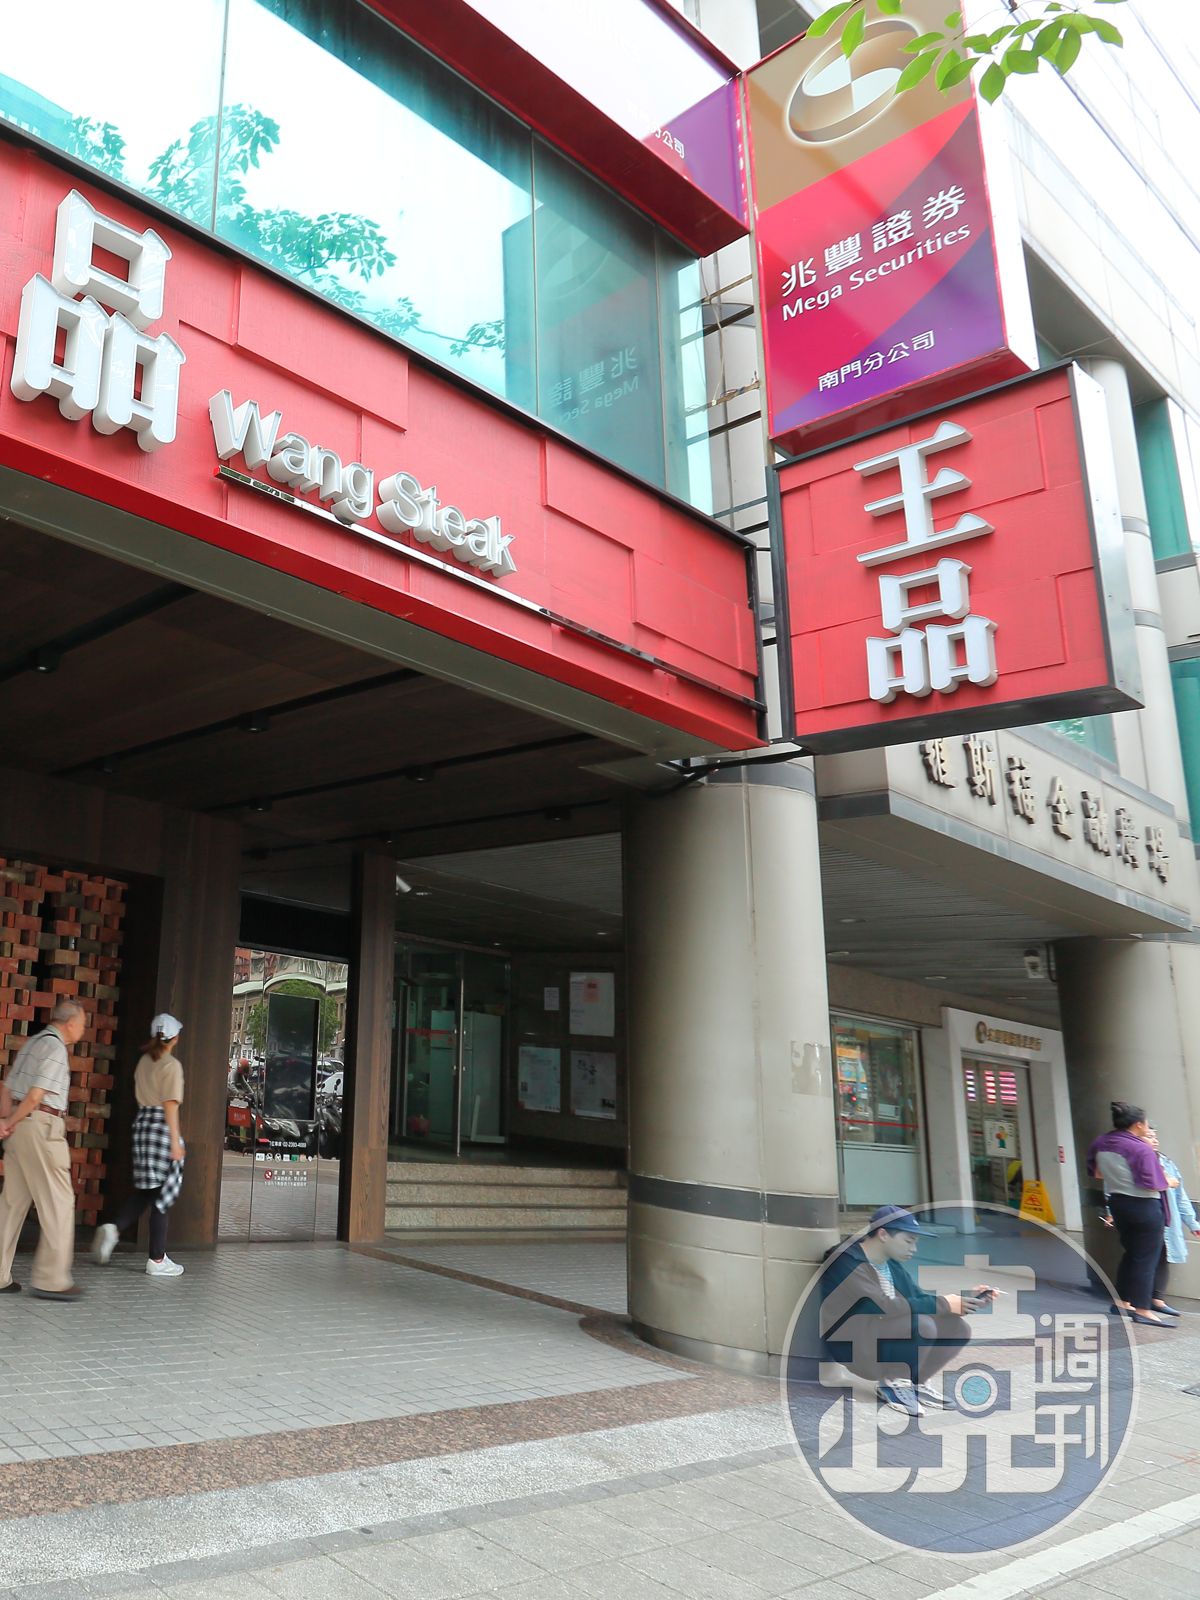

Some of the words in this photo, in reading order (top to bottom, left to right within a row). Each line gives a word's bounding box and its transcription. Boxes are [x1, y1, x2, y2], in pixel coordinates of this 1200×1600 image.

[780, 184, 967, 297] 兆豐證券
[781, 284, 843, 321] Mega
[850, 222, 971, 292] Securities
[817, 329, 935, 392] 南門分公司
[209, 388, 375, 526] Wang
[377, 469, 517, 578] Steak
[852, 420, 998, 704] 王品
